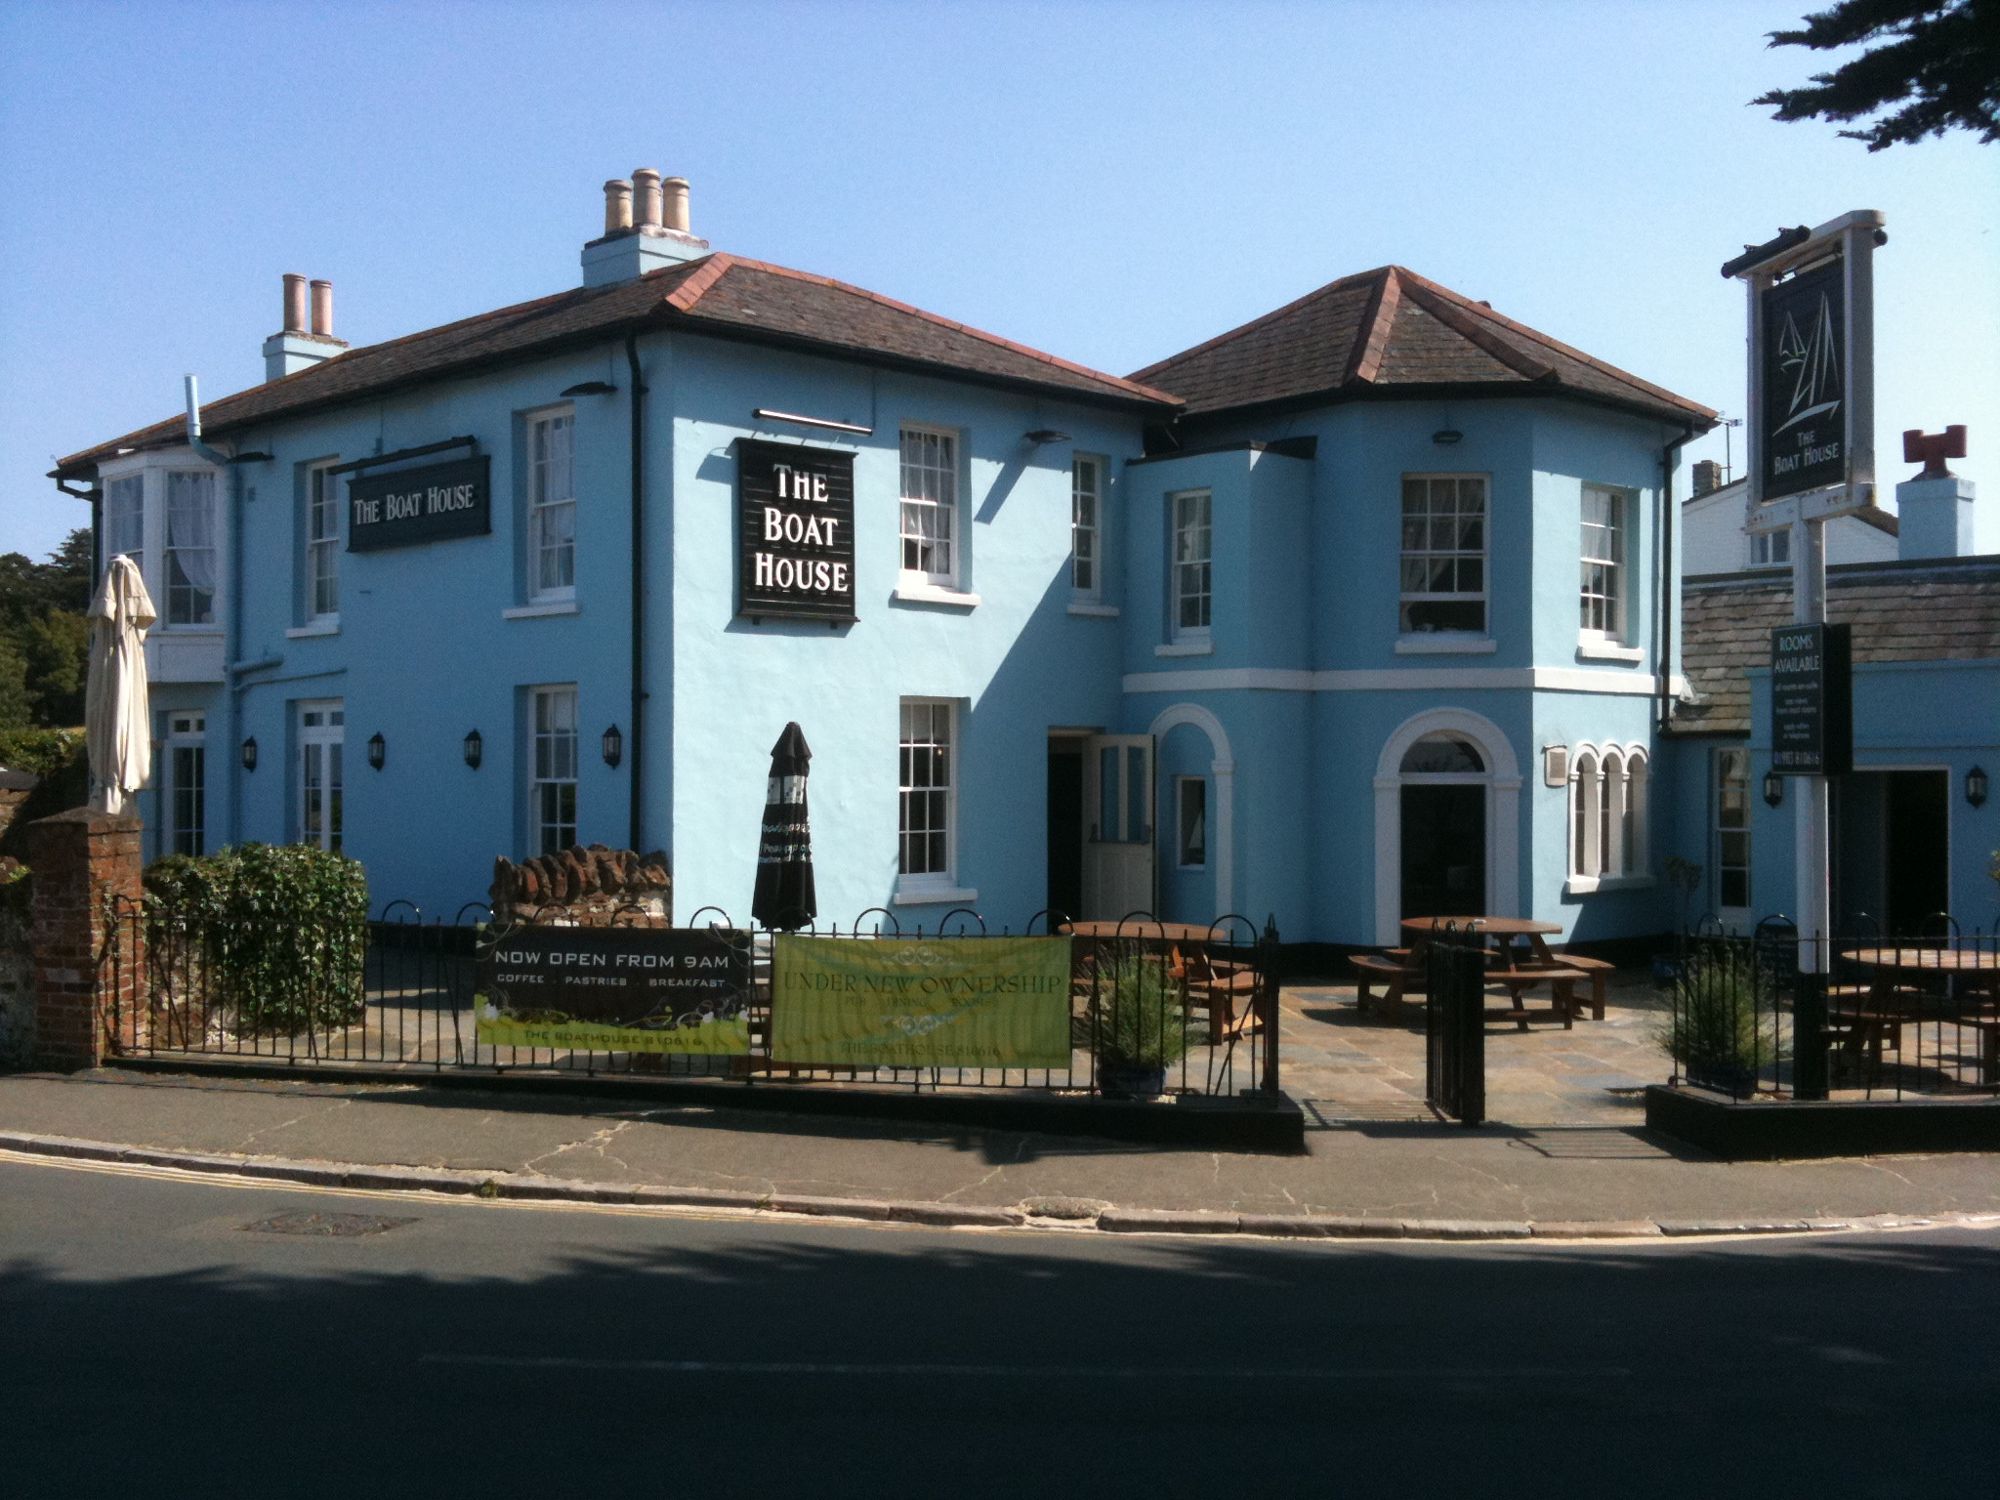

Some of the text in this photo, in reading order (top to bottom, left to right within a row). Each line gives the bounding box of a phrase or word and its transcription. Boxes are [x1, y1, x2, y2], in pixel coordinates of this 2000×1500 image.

[1797, 430, 1815, 446] THE
[1774, 442, 1839, 475] BOAT HOUSE
[773, 463, 829, 503] THE
[354, 484, 474, 525] THE BOAT HOUSE
[764, 507, 839, 546] BOAT
[755, 552, 849, 592] HOUSE
[1779, 635, 1813, 651] ROOMS
[1774, 655, 1820, 673] AVAILABLE
[495, 951, 729, 969] NOW OPEN FROM 9AM
[497, 974, 725, 988] COFFEE PASTRIES BREAKFAST
[783, 971, 1062, 995] UNDER NEW OWNERSHIP
[524, 1030, 549, 1040] THE
